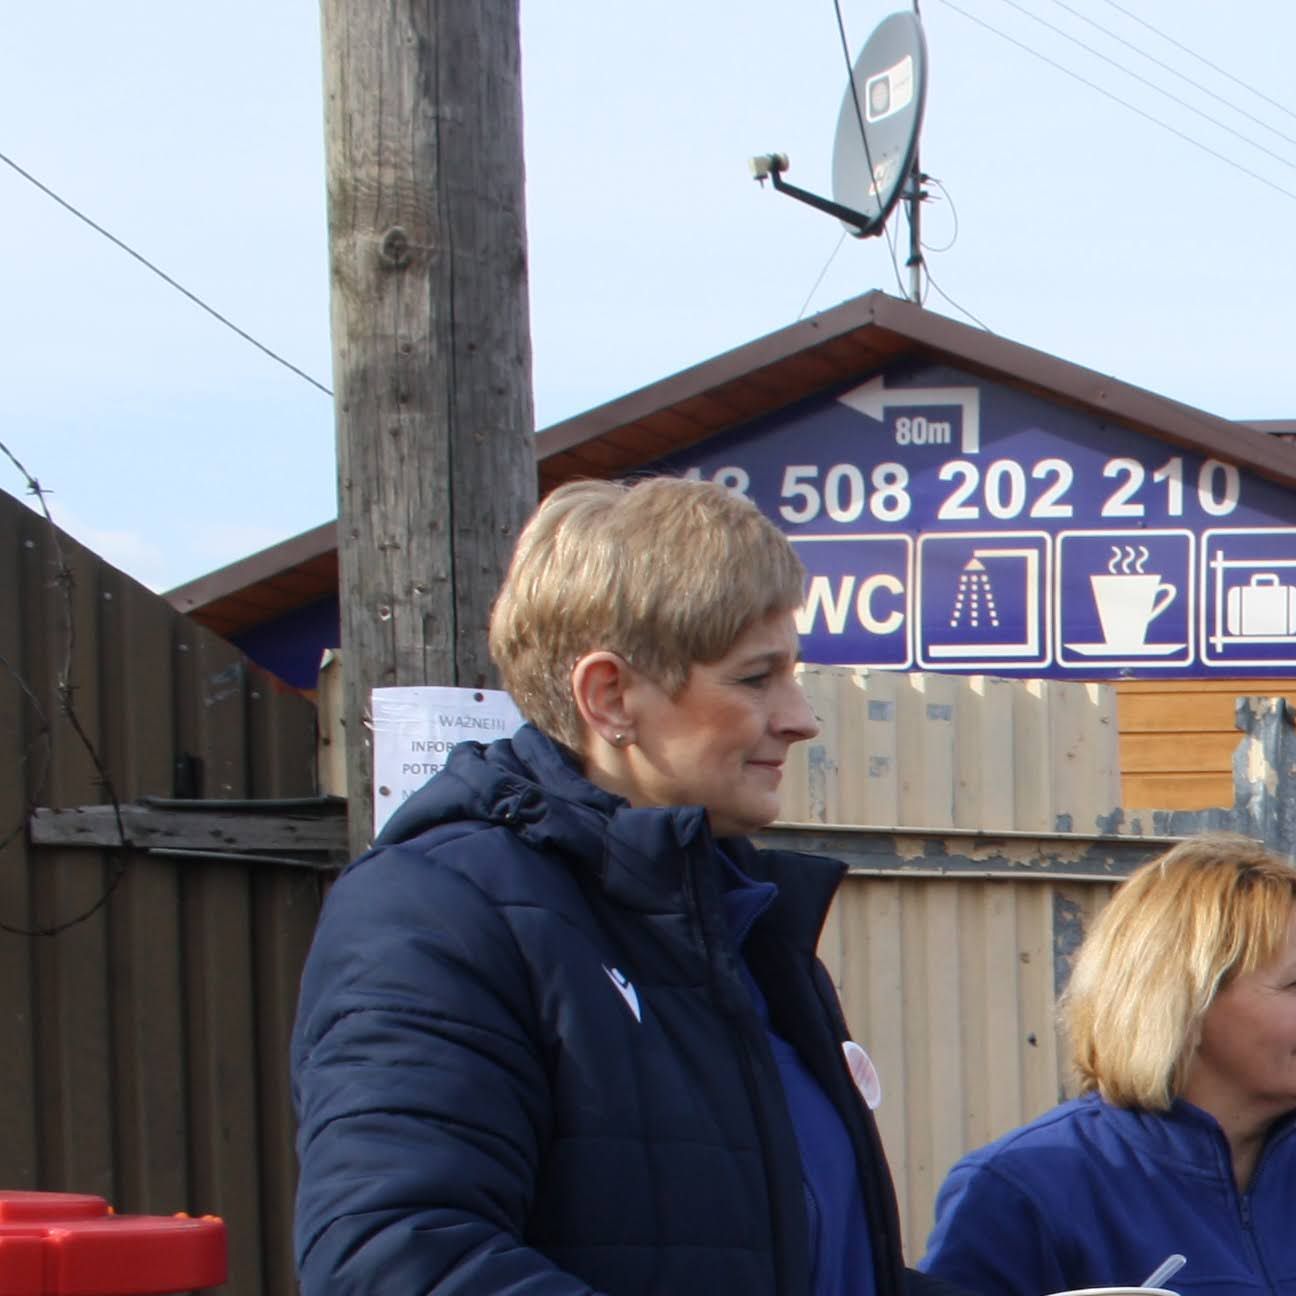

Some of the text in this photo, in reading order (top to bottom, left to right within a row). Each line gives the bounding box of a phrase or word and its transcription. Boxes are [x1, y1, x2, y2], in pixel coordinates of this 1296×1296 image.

[895, 417, 950, 445] 80m
[684, 457, 1240, 523] 8 508 202 210
[793, 573, 905, 635] WC
